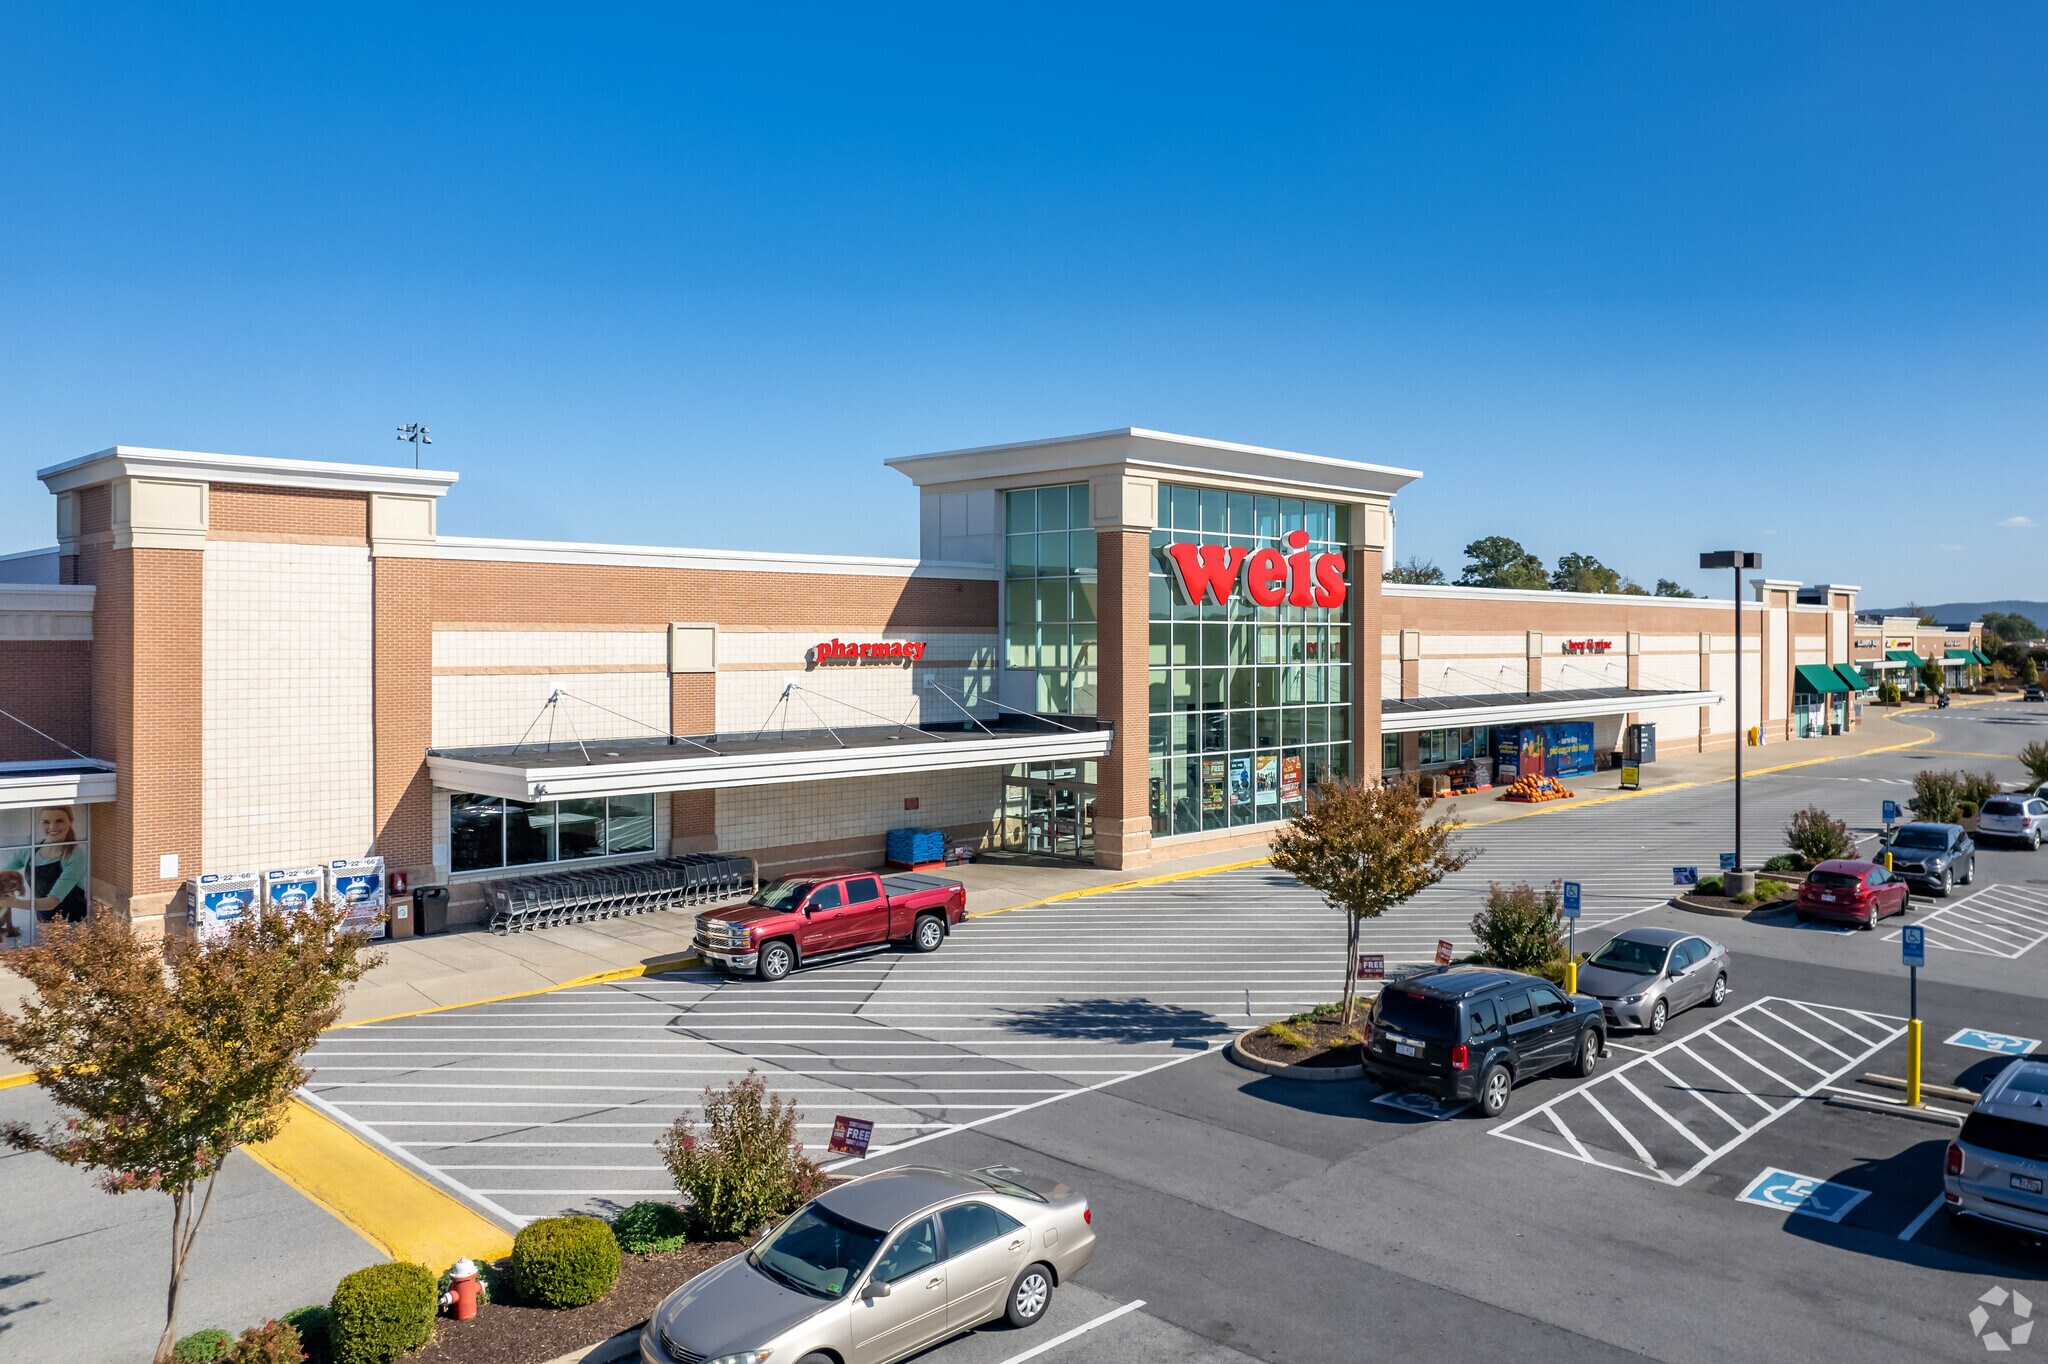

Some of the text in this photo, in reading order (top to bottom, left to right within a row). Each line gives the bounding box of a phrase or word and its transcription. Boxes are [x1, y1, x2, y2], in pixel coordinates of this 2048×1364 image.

[1167, 530, 1346, 609] weis
[815, 638, 927, 662] pharmacy
[1568, 639, 1585, 650] beer
[1595, 641, 1612, 649] wine
[1211, 765, 1225, 773] FREE
[1363, 961, 1384, 969] FREE
[846, 1127, 870, 1142] FREE
